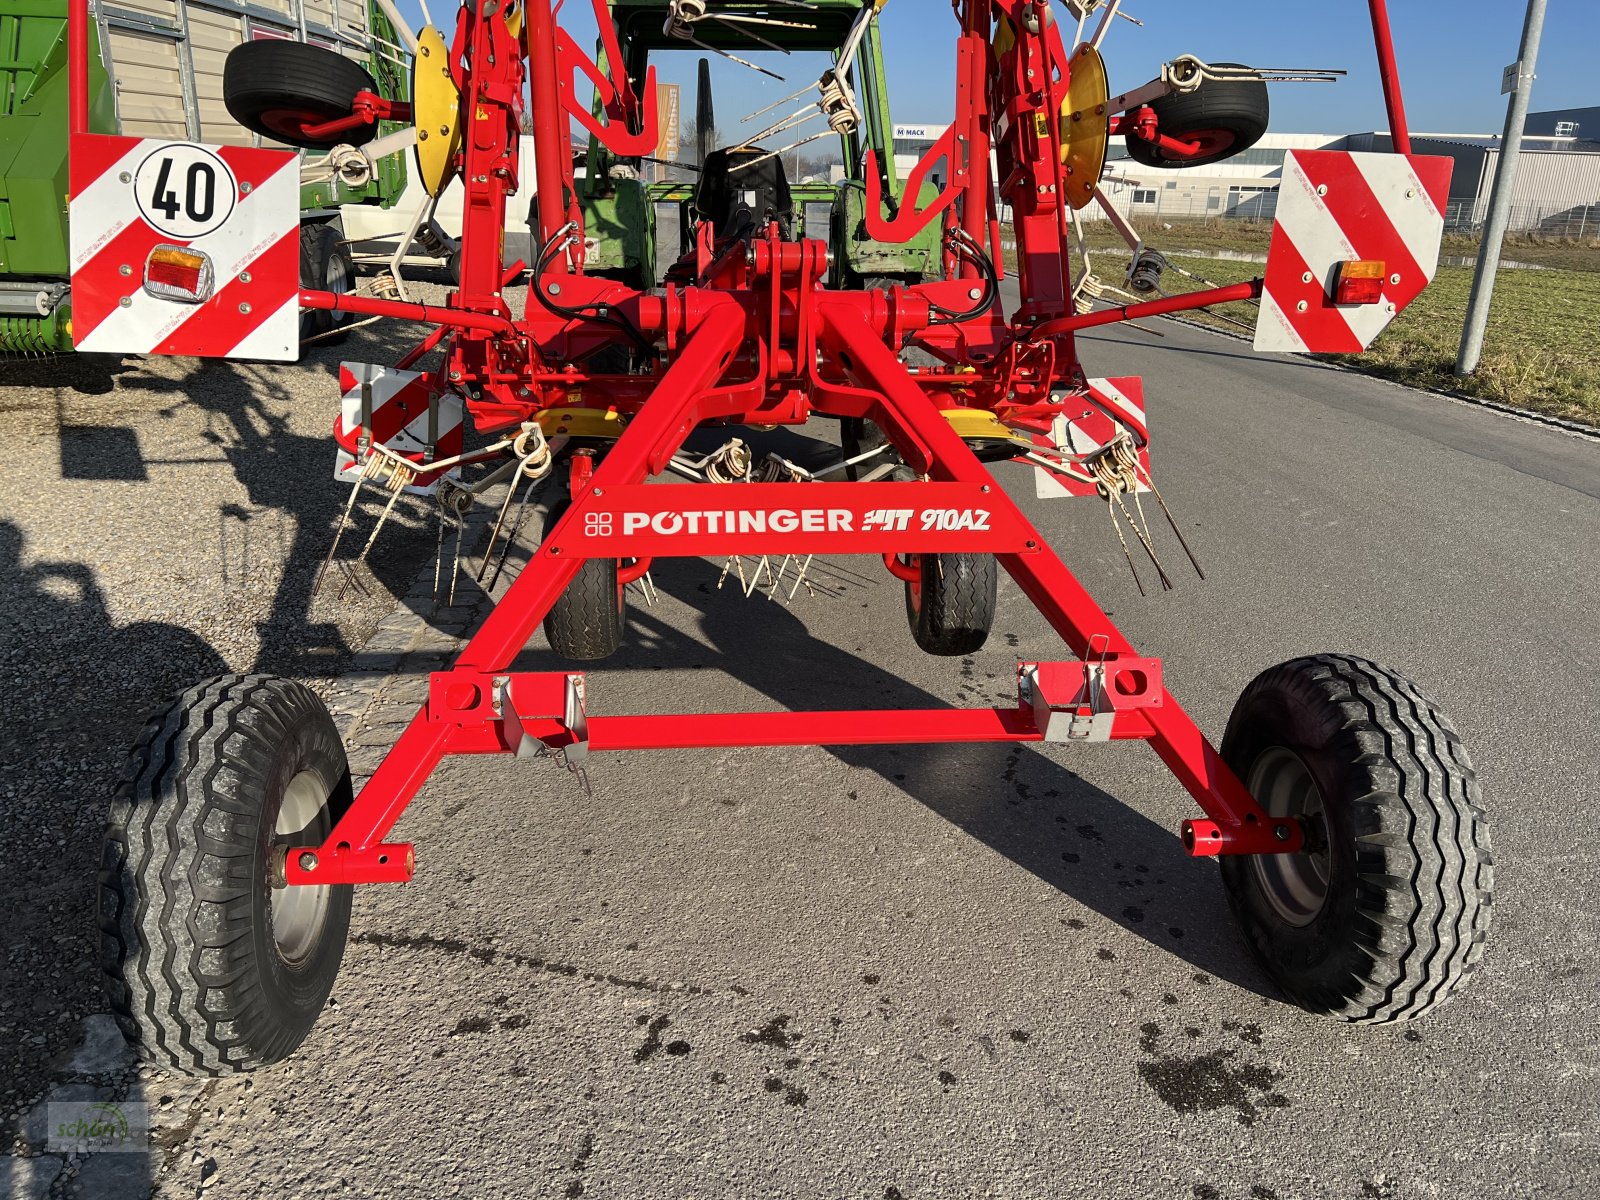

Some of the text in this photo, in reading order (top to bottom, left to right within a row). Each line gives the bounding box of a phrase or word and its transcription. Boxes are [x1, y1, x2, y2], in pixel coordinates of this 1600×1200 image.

[152, 157, 216, 223] 40
[623, 508, 991, 536] PÖTTINGER HIT 910AZ
